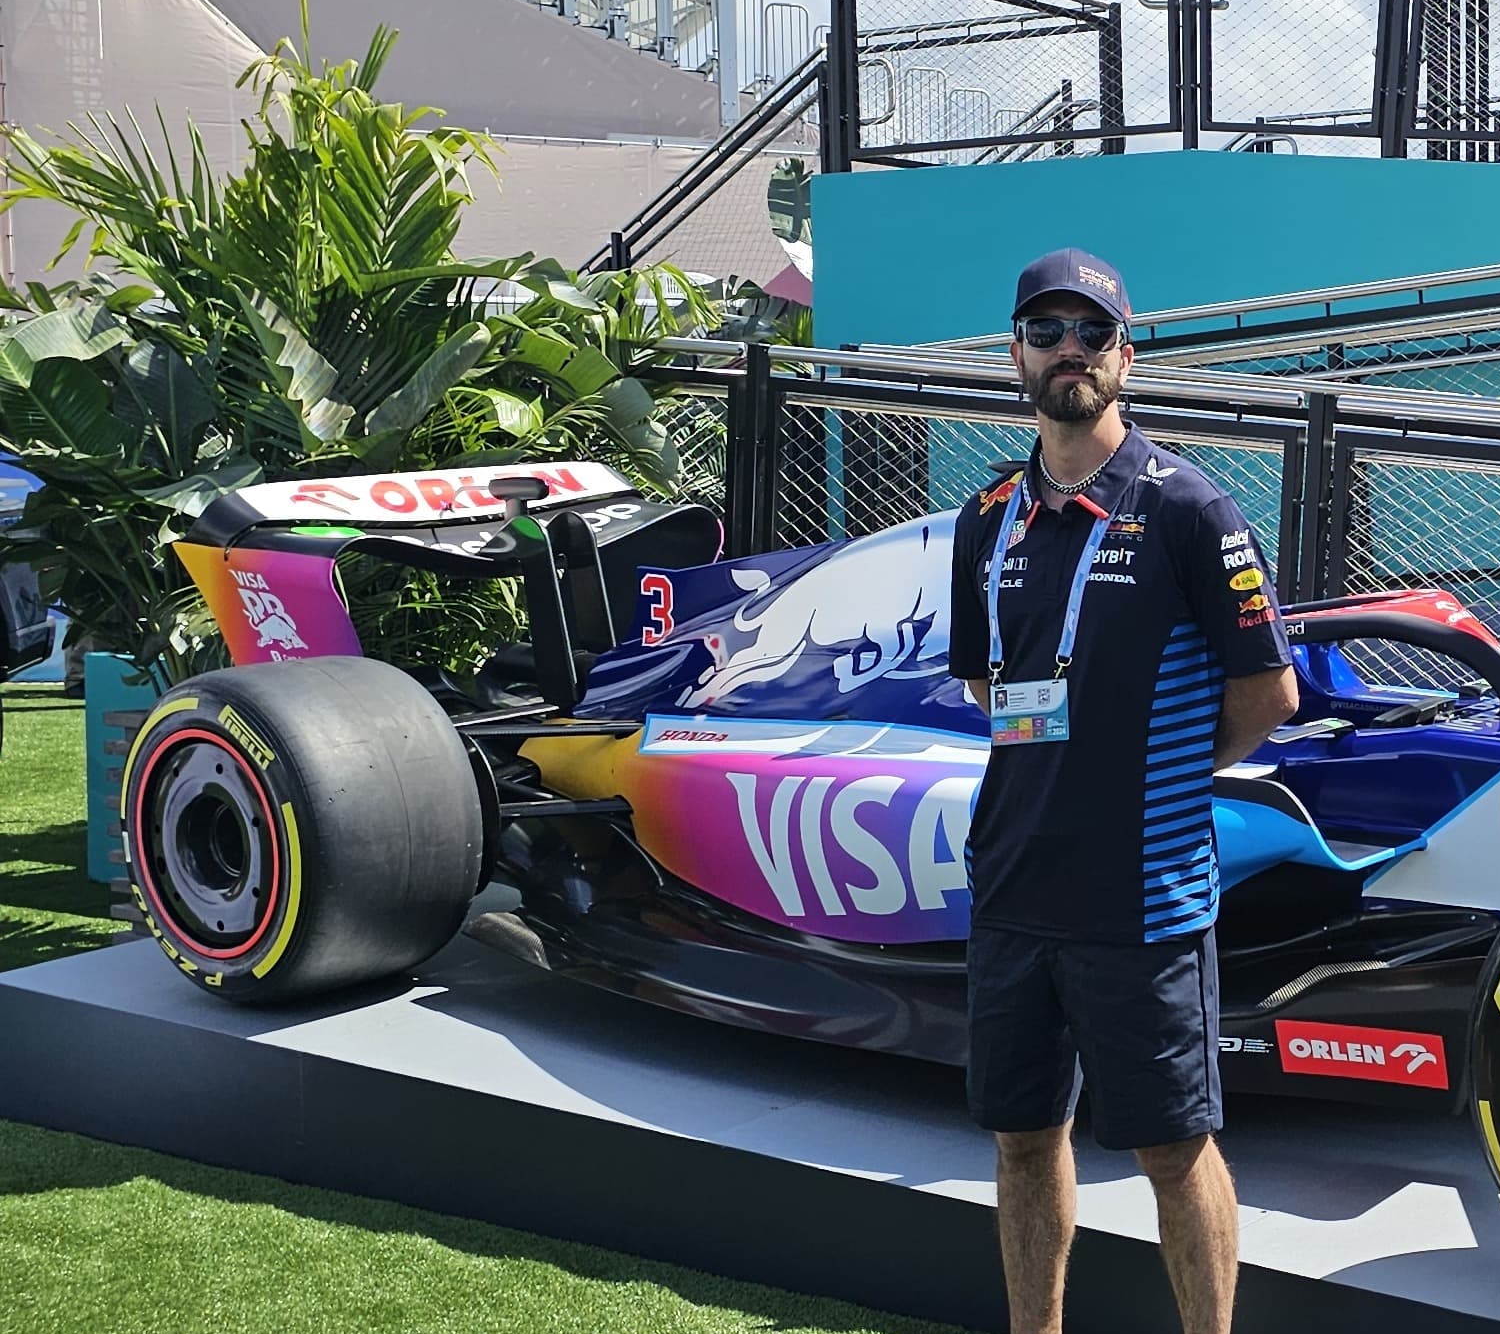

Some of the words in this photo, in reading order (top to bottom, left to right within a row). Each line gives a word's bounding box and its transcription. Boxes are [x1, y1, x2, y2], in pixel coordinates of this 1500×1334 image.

[369, 468, 589, 514] ORLN
[1112, 513, 1148, 524] ACLE
[228, 569, 270, 591] VISA
[1086, 572, 1137, 585] HONDA
[640, 573, 675, 648] 3
[217, 704, 275, 771] PIRELLI
[726, 771, 984, 917] VISA
[131, 883, 200, 977] ZERO
[204, 971, 224, 987] P
[1288, 1038, 1386, 1065] ORLEN
